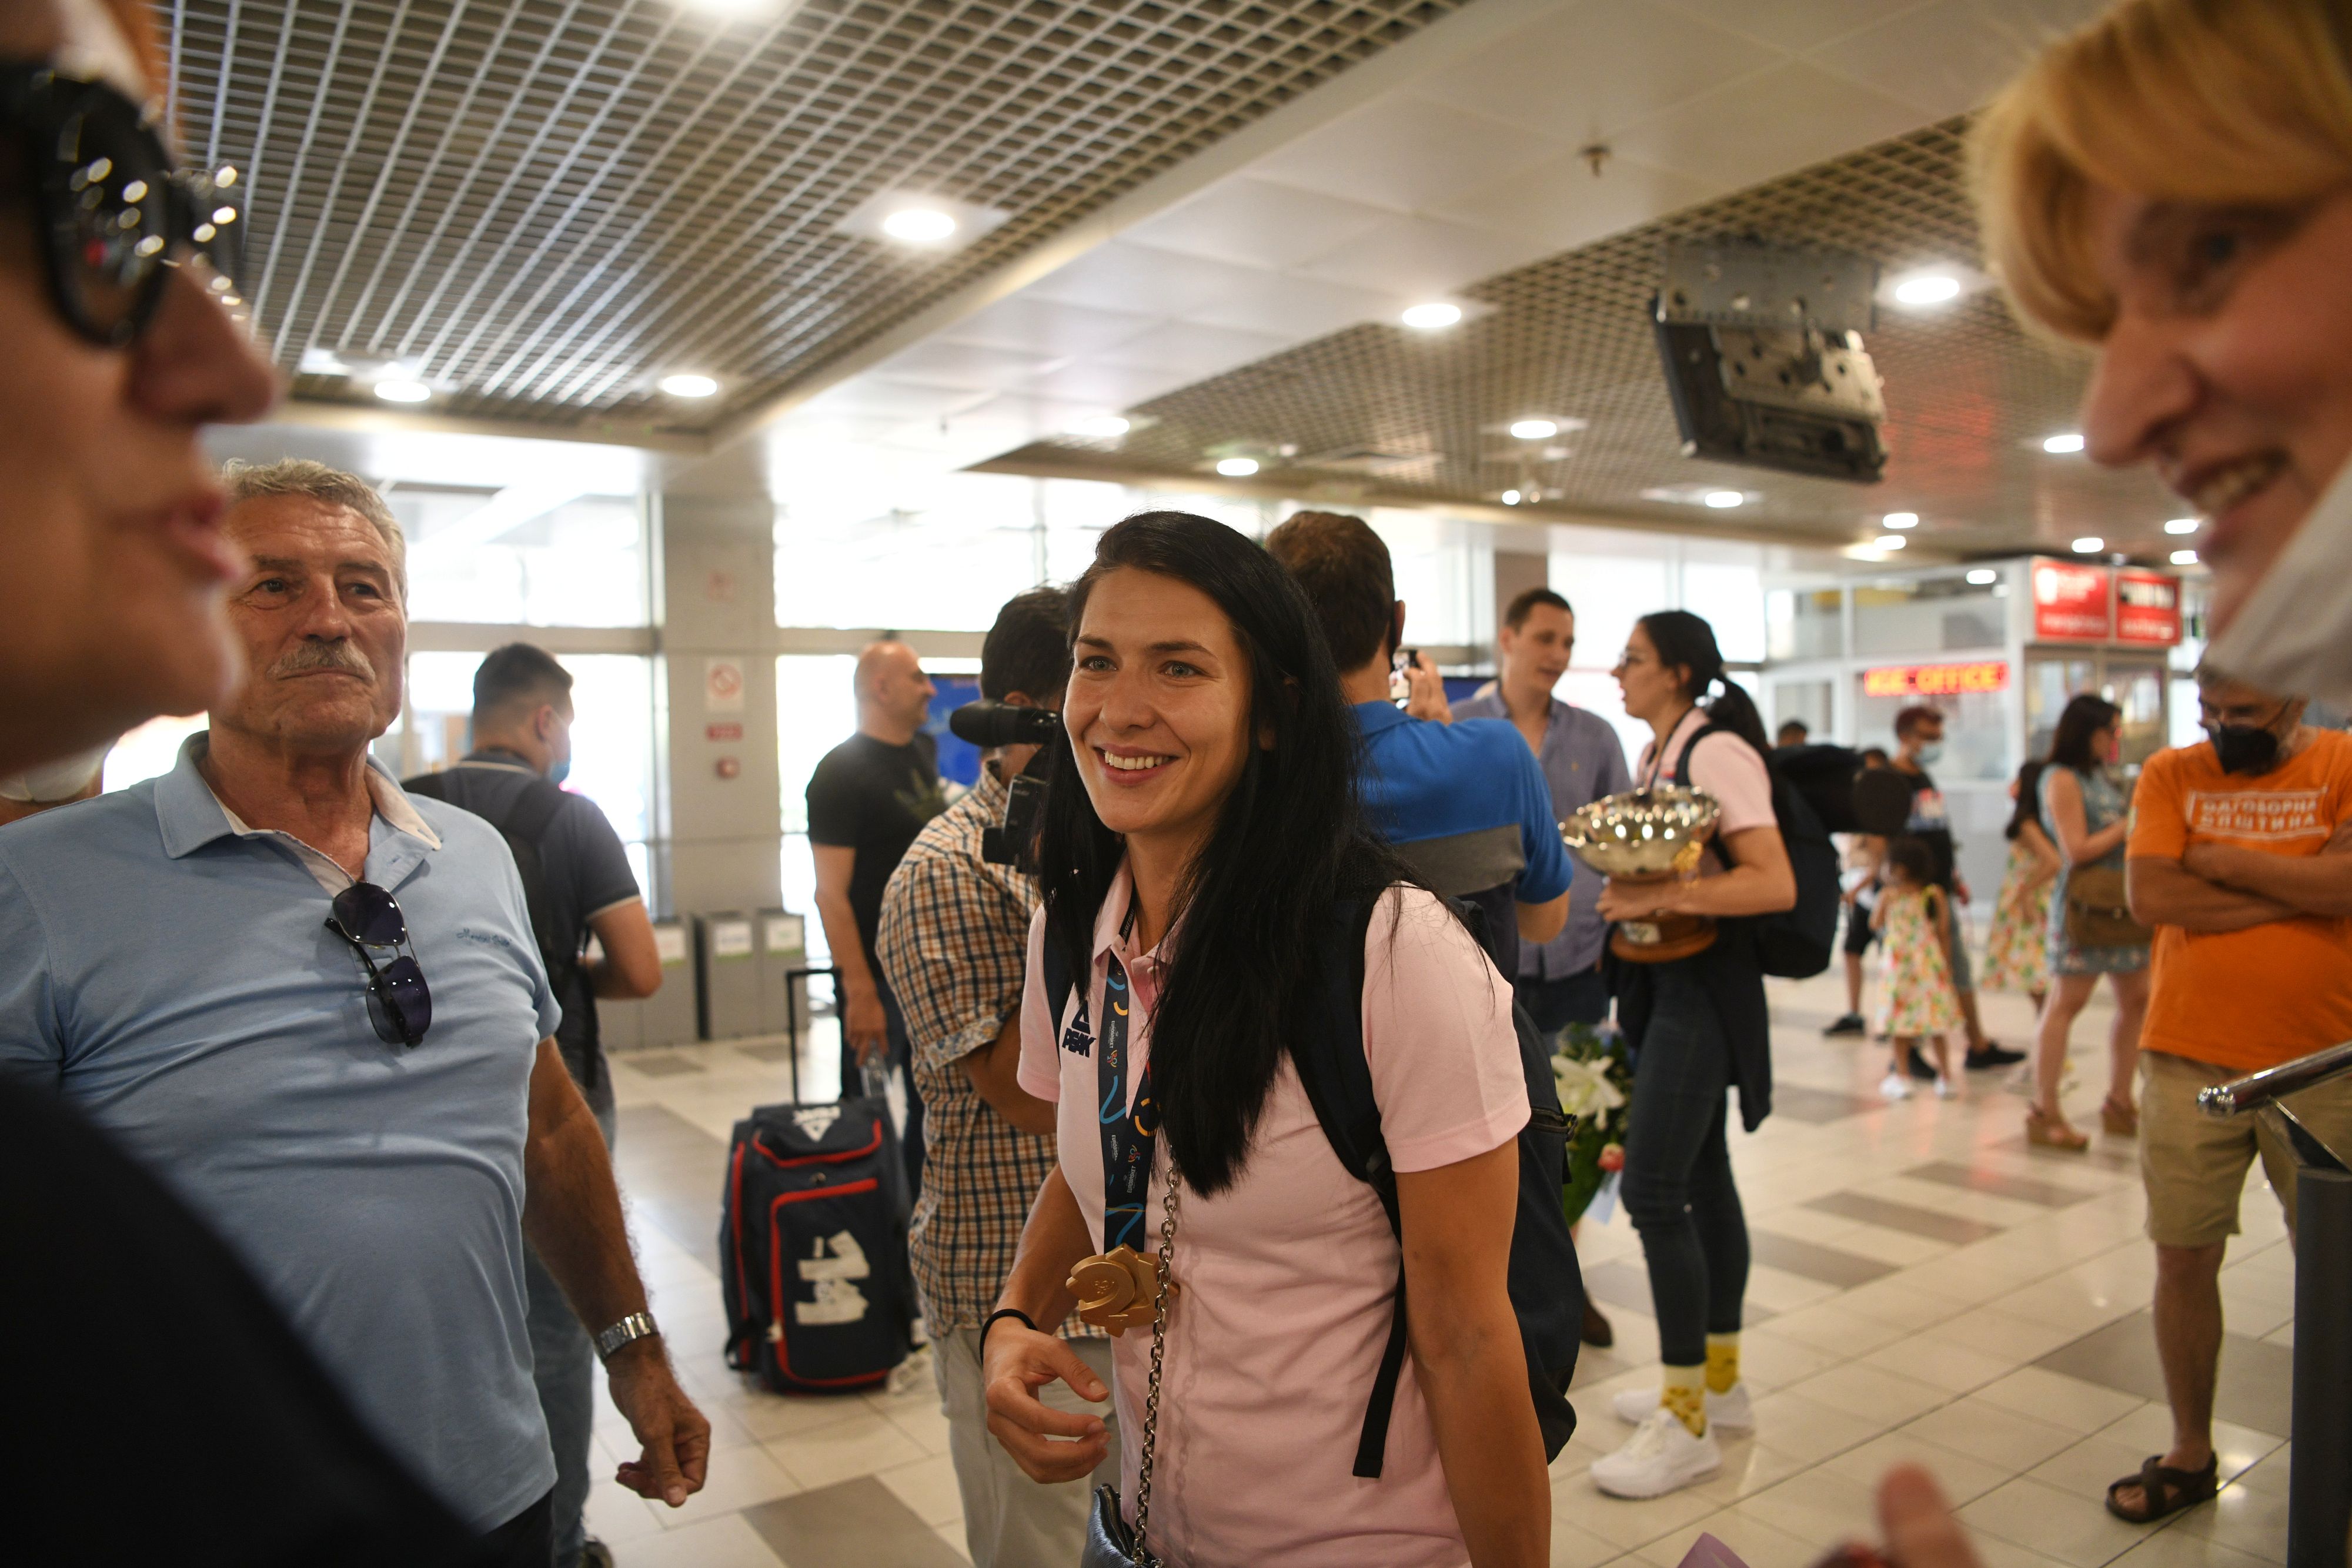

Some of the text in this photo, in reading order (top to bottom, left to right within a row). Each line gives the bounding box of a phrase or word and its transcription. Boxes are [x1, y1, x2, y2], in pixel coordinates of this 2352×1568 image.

[1916, 664, 1999, 694] OFFICE
[2200, 814, 2316, 831] ОПШТИНА
[1062, 1028, 1096, 1058] PEAK
[1127, 1165, 1137, 1193] EUROBASKET
